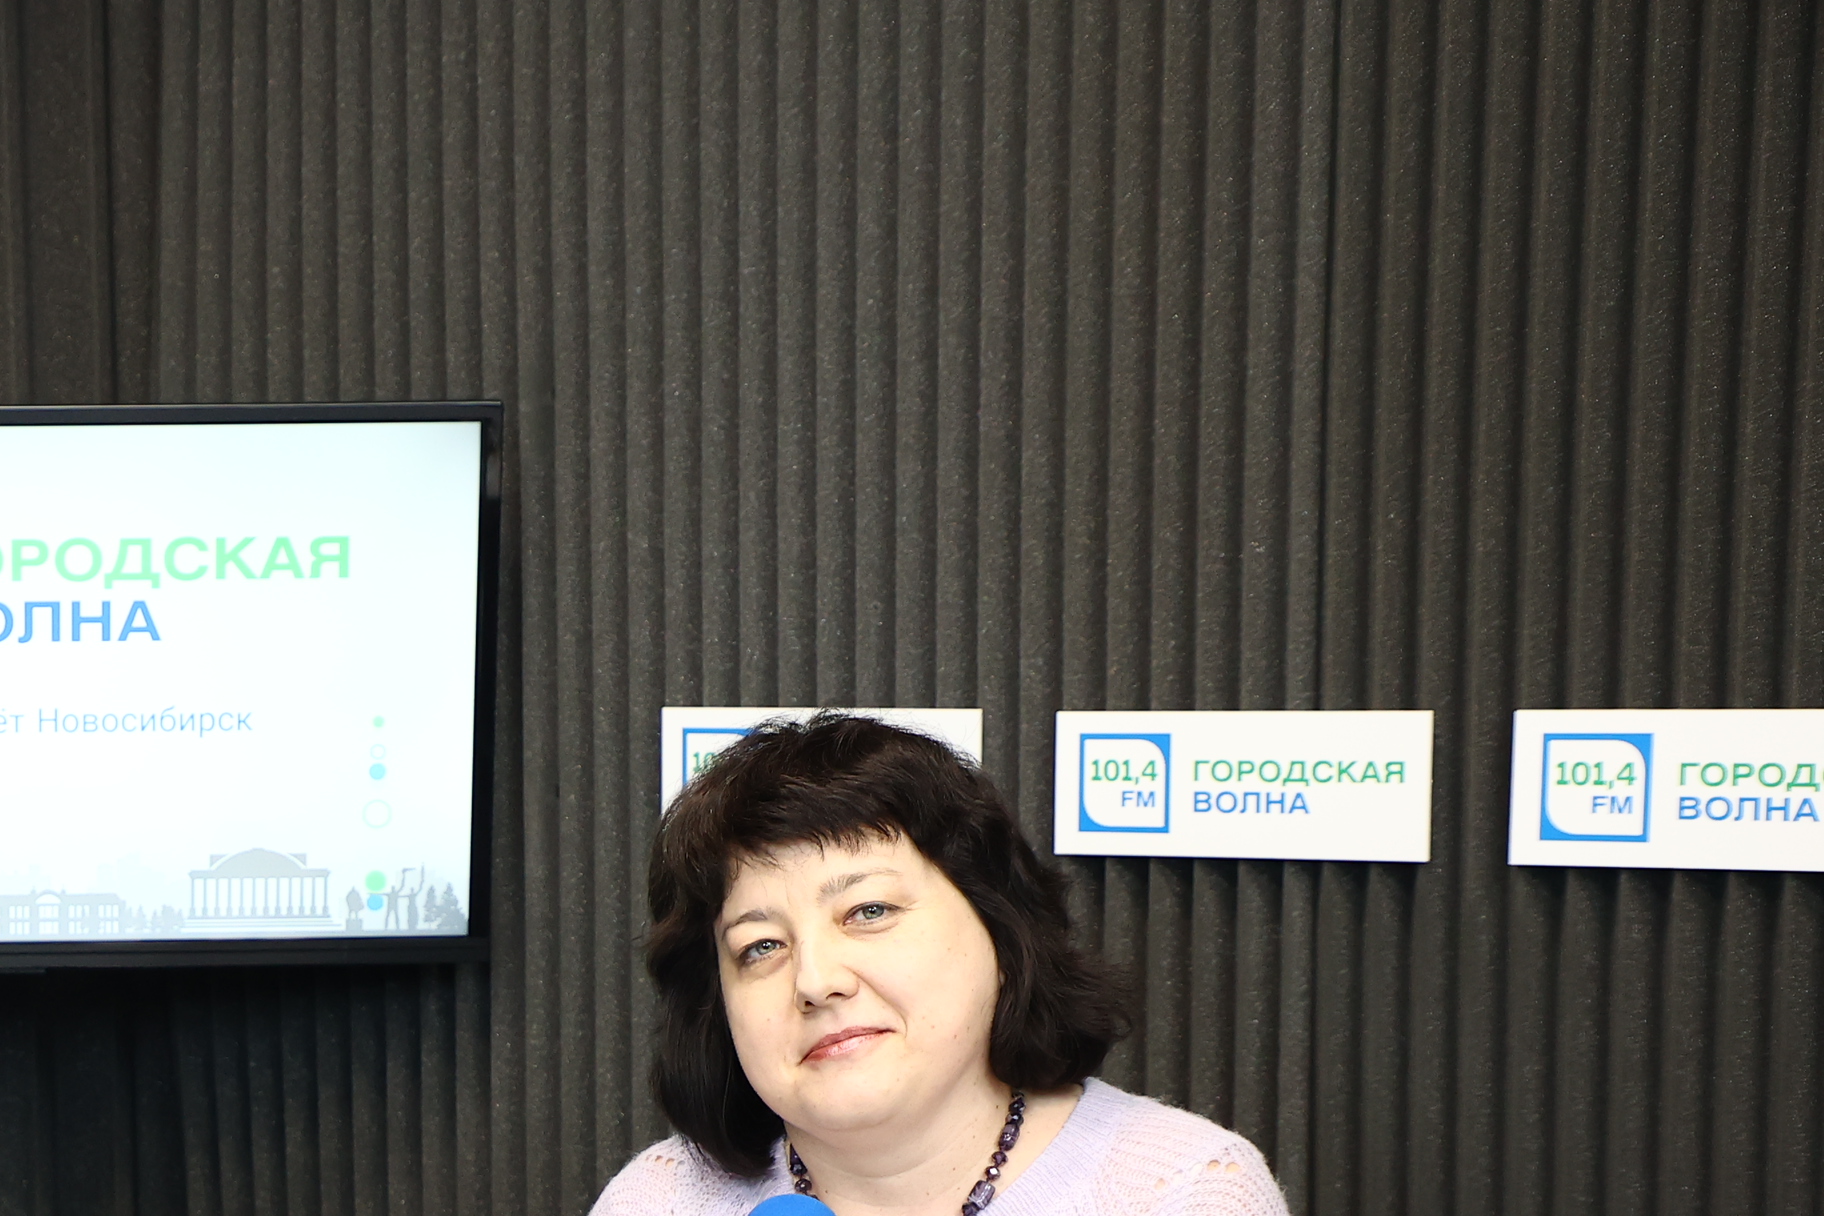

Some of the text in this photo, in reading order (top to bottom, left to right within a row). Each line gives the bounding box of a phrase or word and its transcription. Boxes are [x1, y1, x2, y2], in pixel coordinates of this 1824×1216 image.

[37, 706, 253, 738] Новосибирск
[1090, 759, 1158, 785] 101,4
[1193, 759, 1406, 787] ГОРОДСКАЯ
[1555, 760, 1637, 790] 101,4
[1679, 761, 1824, 793] ГОРОД
[1121, 790, 1156, 808] FM
[1193, 790, 1311, 815] ВОЛНА
[1591, 795, 1634, 815] FM
[1678, 795, 1821, 822] ВОЛНА
